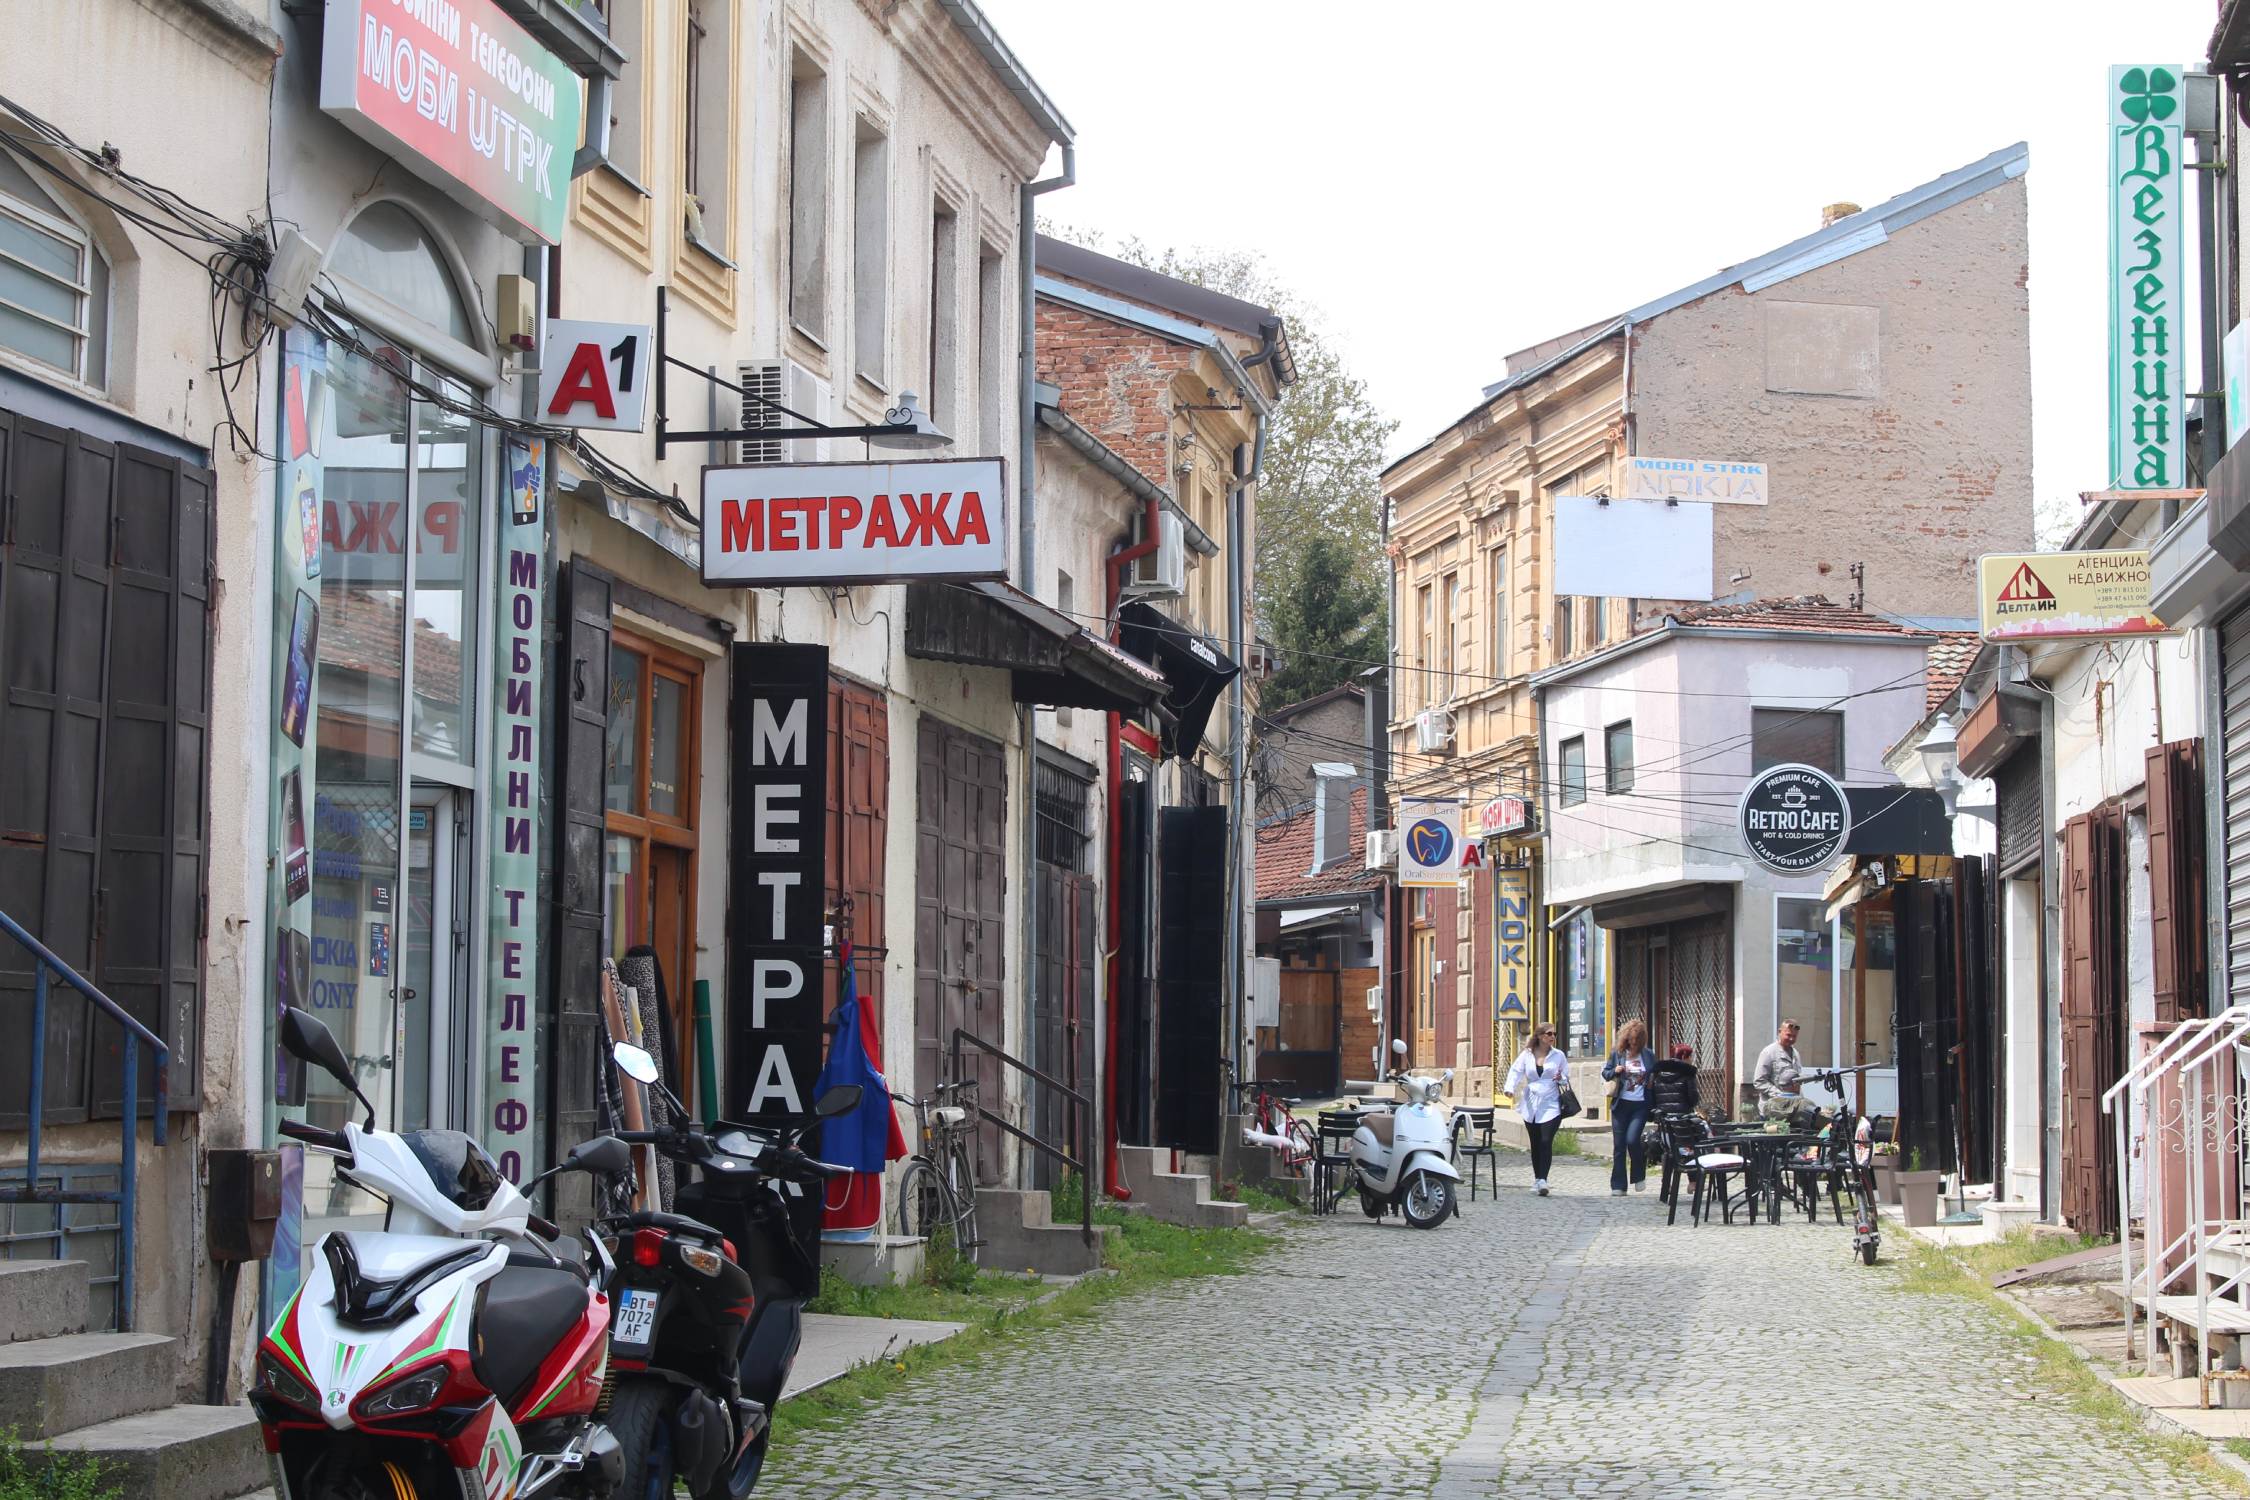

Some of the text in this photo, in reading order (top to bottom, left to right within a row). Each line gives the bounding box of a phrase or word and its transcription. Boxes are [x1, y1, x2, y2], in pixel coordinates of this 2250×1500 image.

[364, 13, 554, 201] МОБИ ШТРК
[547, 335, 638, 420] A1
[1634, 460, 1763, 475] MOBI STRK
[1635, 472, 1762, 500] NOKIA
[720, 491, 991, 553] МЕТРАЖА
[2077, 556, 2144, 570] АГЕНЦИЈА
[505, 549, 538, 856] МОБИЛНИ
[1765, 773, 1821, 789] PREMIUM CAFE
[1749, 808, 1840, 831] RETRO CAFE
[1762, 831, 1776, 839] HOT
[1784, 832, 1802, 840] COLD
[1802, 832, 1825, 840] DRINKS
[1461, 841, 1486, 868] A1
[1754, 840, 1833, 866] START YOUR DAY WELL
[1499, 897, 1527, 1015] NOKIA
[630, 1297, 647, 1310] BT
[620, 1309, 652, 1325] 7072
[624, 1324, 641, 1337] AF
